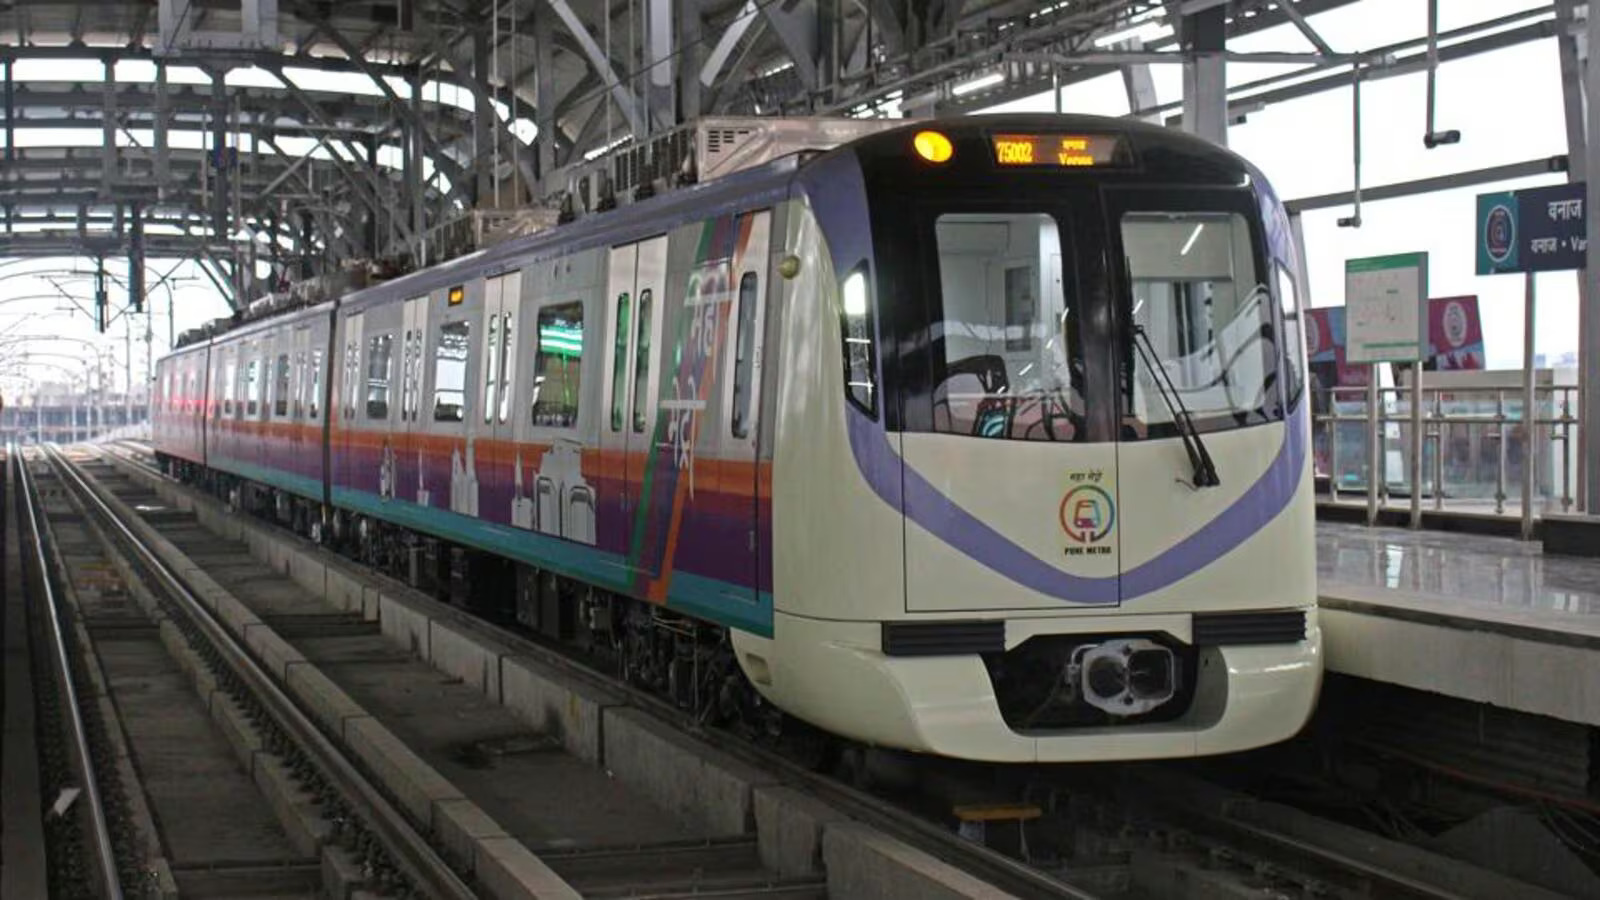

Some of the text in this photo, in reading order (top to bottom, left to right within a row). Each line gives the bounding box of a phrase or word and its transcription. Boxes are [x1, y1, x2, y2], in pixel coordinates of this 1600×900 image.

[996, 141, 1033, 163] 75002
[1548, 200, 1582, 221] वनाज
[1064, 547, 1083, 555] PUNE
